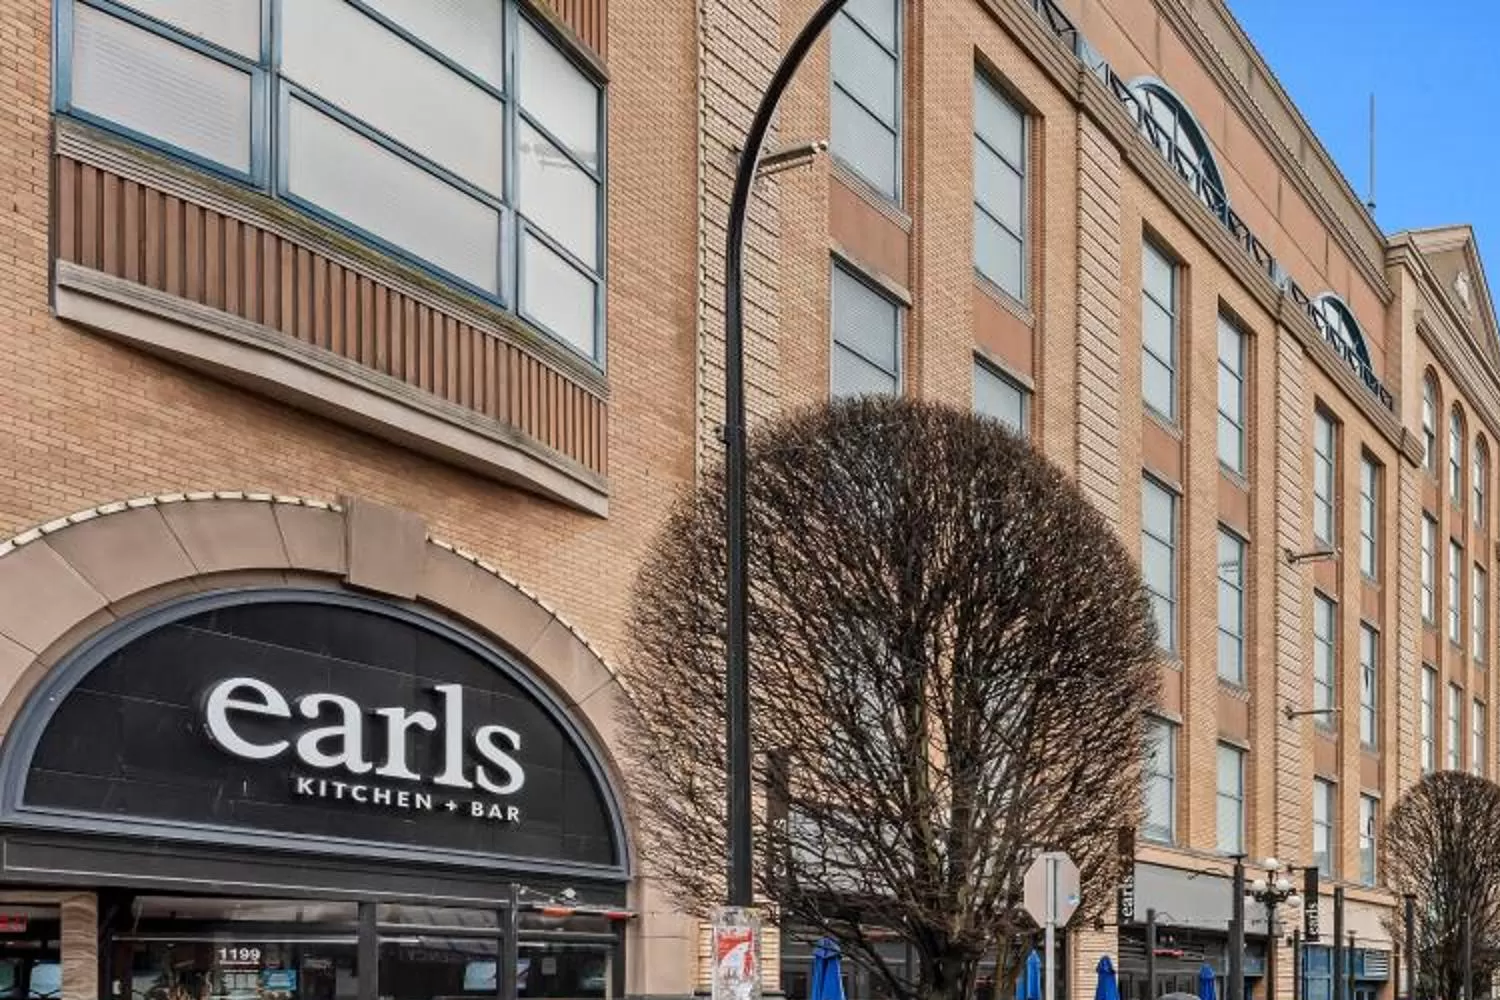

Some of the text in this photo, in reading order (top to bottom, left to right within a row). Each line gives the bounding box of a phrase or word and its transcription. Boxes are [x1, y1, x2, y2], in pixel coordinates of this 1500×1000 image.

[206, 676, 526, 795] earls
[298, 777, 433, 810] KITCHEN
[471, 800, 520, 822] BAR
[219, 947, 261, 961] 1199
